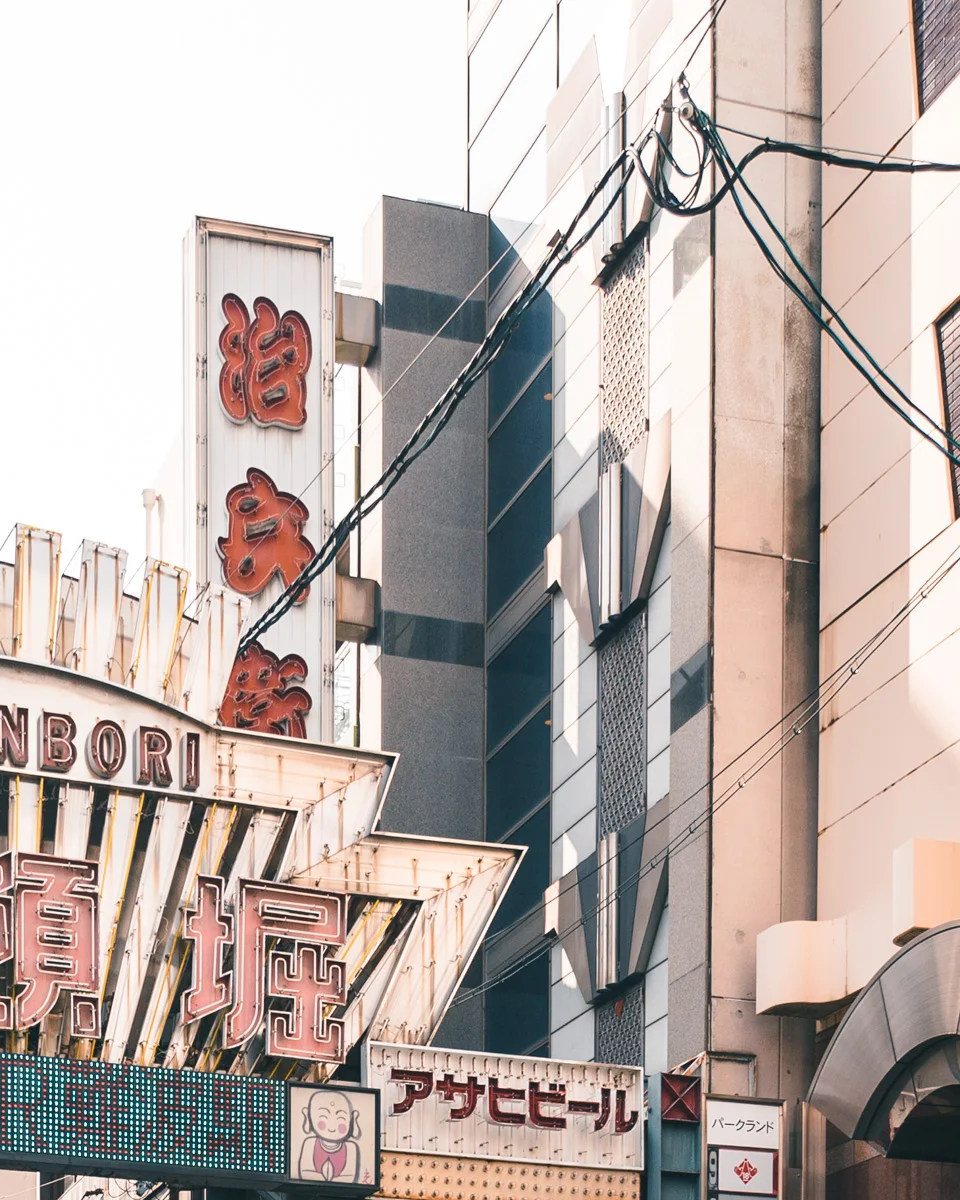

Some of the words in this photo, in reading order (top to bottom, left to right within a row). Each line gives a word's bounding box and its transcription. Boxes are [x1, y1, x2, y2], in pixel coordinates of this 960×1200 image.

[386, 1066, 641, 1135] アサヒビール
[711, 1116, 775, 1135] パークランド
[709, 1150, 718, 1185] 9
